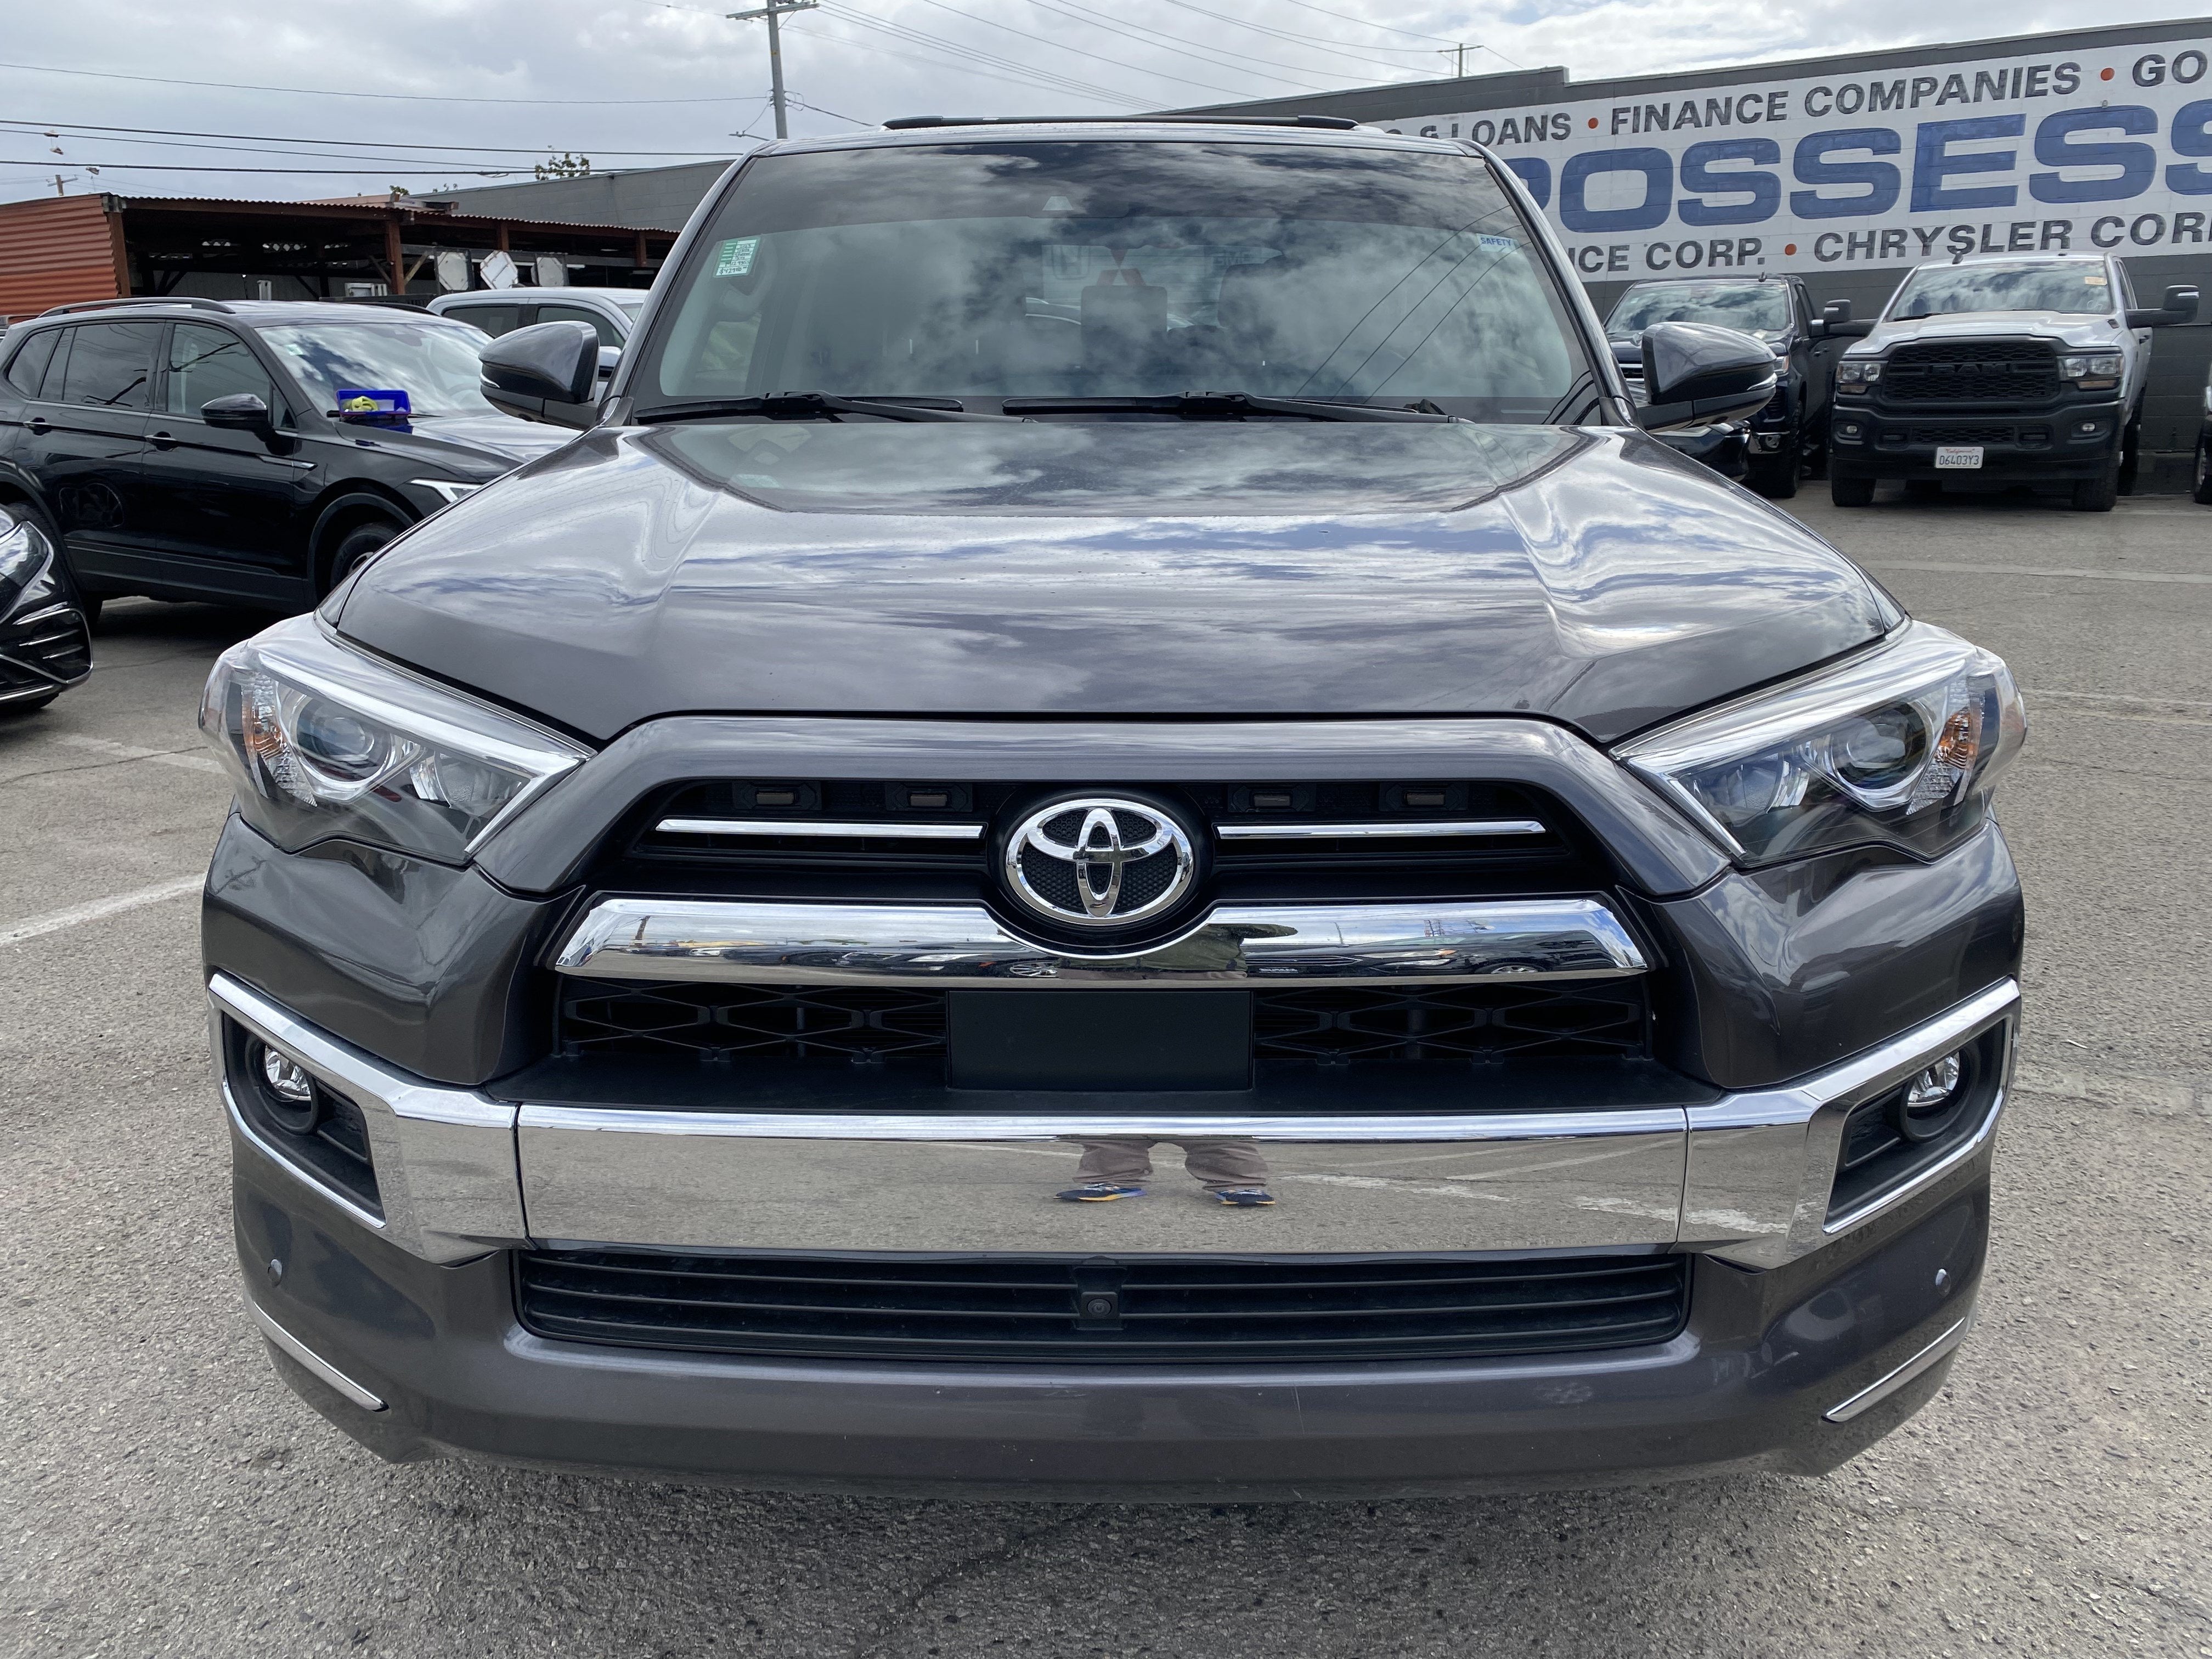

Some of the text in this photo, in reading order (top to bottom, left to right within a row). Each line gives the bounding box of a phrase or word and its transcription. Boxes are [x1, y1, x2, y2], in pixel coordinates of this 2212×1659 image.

[1611, 91, 1789, 135] FINANCE
[1804, 62, 2081, 117] COMPANIES
[2132, 50, 2208, 87] GO
[1480, 237, 1511, 246] SAFETY
[1646, 237, 1765, 270] CORP.
[1814, 219, 2073, 262] CHRYSLER
[2091, 212, 2212, 248] COR
[1932, 363, 2007, 375] RAM
[1939, 455, 1979, 465] 06403Y3
